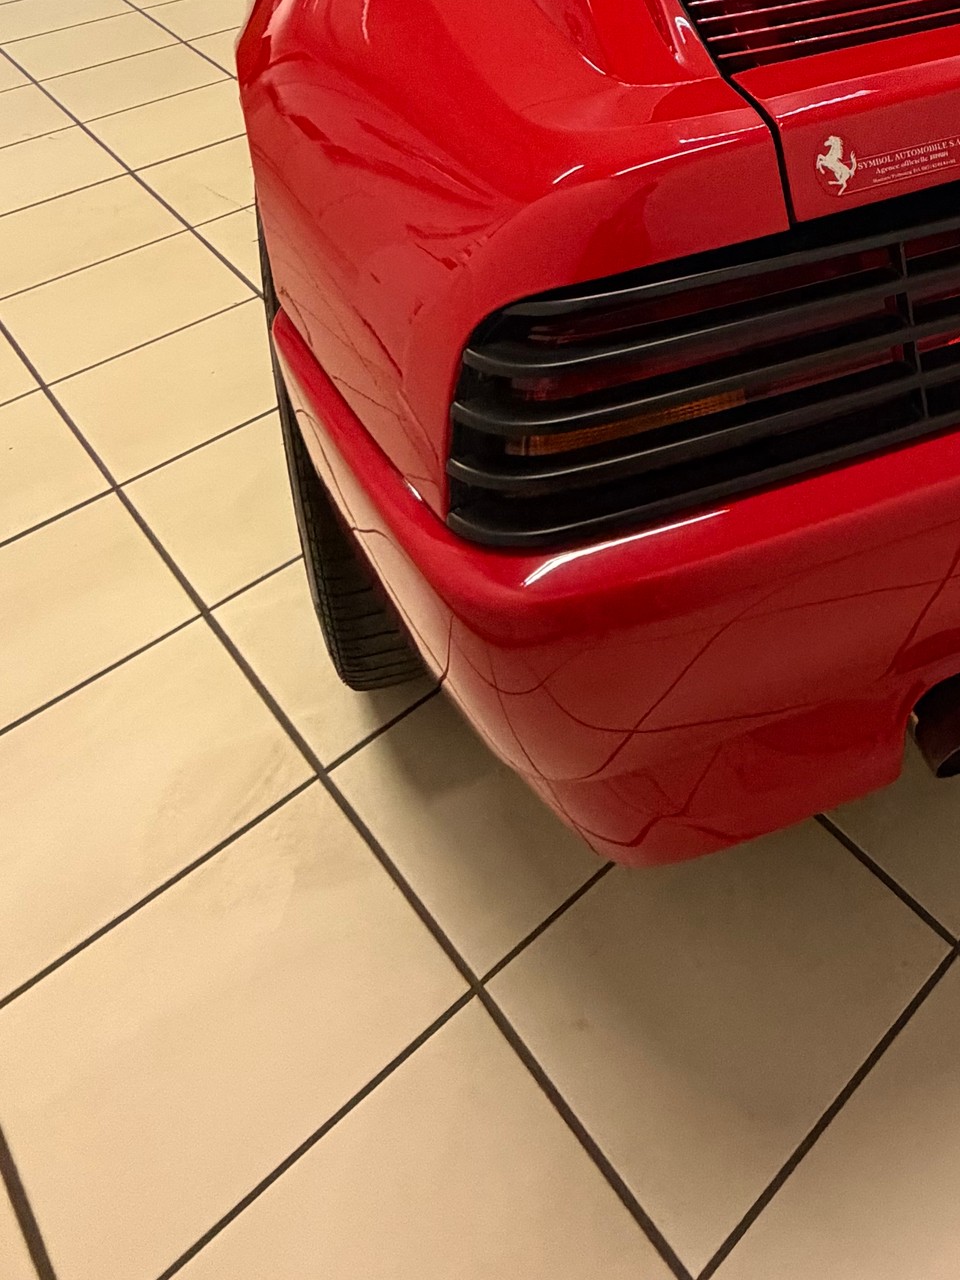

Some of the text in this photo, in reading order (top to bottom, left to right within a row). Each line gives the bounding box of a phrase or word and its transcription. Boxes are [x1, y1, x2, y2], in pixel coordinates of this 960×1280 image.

[857, 155, 894, 170] SYMBOL
[894, 141, 948, 161] AUTOMOBILE
[874, 162, 900, 176] Agence
